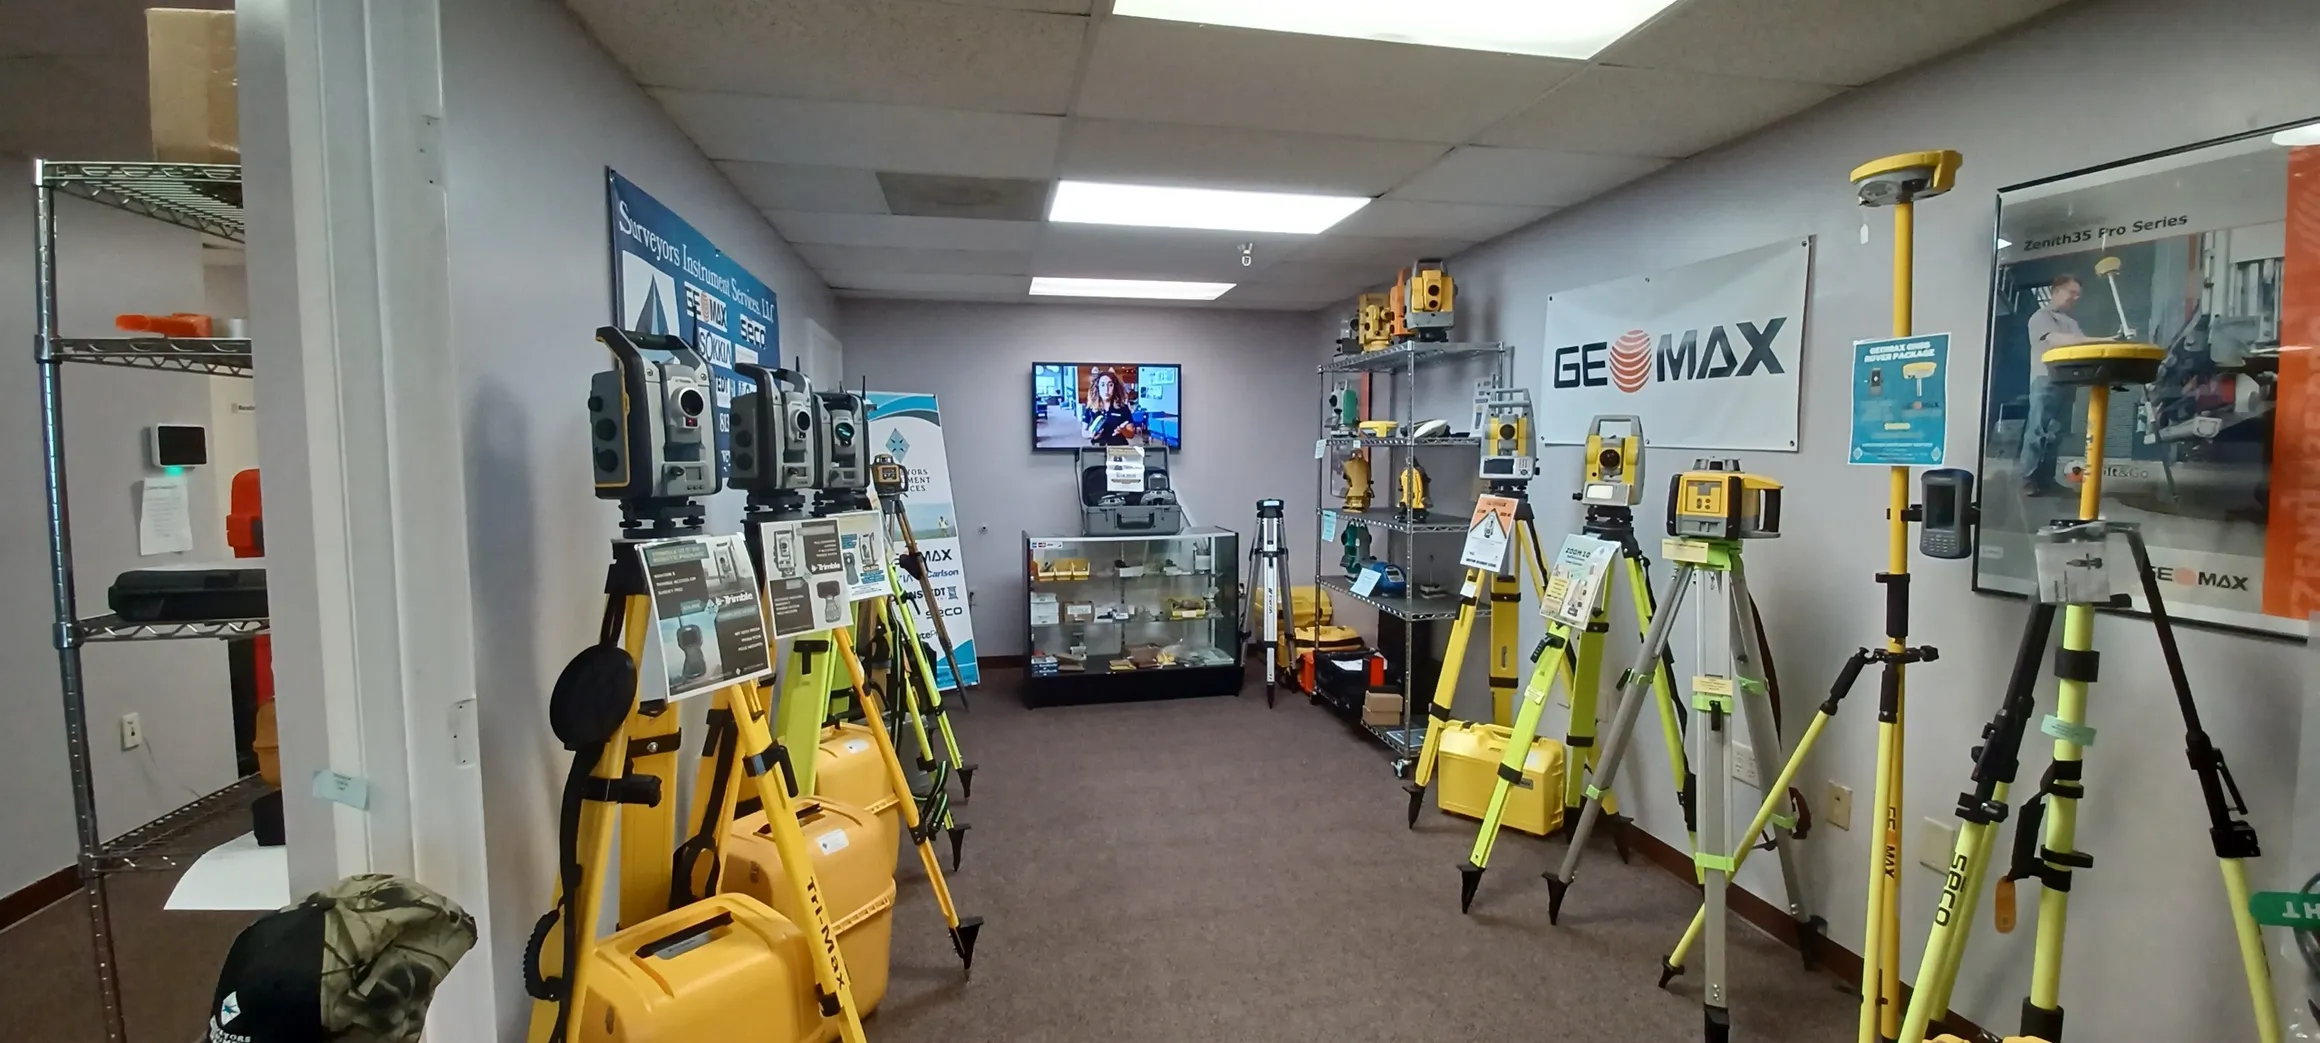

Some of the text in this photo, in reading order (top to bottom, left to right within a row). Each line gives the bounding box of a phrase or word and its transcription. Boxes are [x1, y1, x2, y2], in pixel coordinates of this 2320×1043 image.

[2024, 230, 2092, 251] Zenith35
[2098, 226, 2127, 239] Pro
[2132, 214, 2188, 233] Series
[619, 200, 681, 266] Surveyors
[682, 244, 731, 297] Instrument
[761, 297, 775, 324] LLC
[700, 332, 731, 364] SOKKIA
[1554, 317, 1787, 393] GEOMAX
[818, 562, 841, 572] Trimble
[2151, 565, 2249, 592] EOMAX
[722, 592, 754, 605] Trimble
[807, 875, 845, 990] Tri-Max
